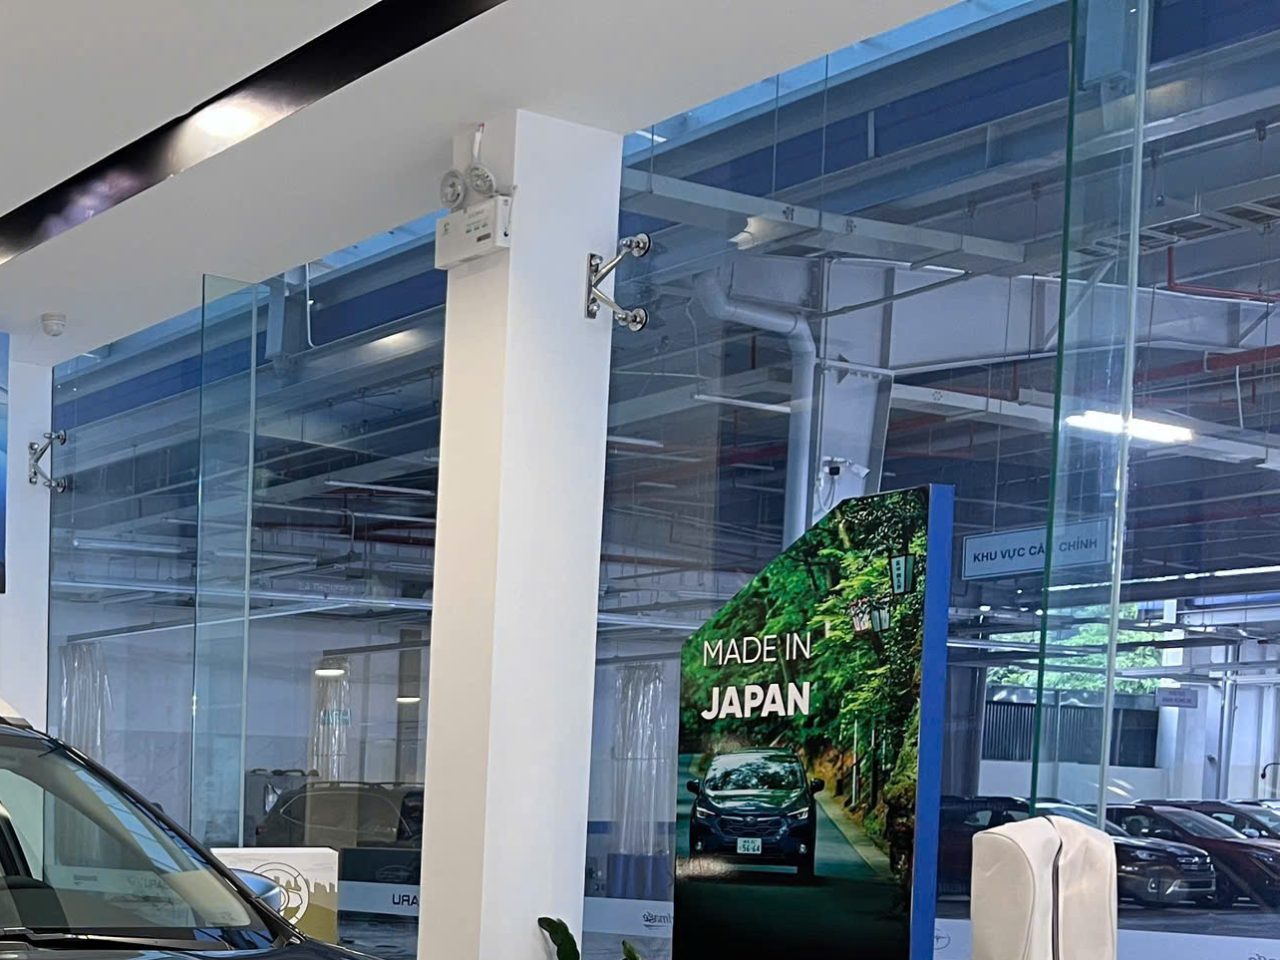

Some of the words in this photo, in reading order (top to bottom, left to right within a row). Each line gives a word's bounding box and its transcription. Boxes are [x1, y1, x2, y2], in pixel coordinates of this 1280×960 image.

[973, 550, 997, 562] KHU
[1000, 547, 1026, 560] VỰC
[1029, 542, 1046, 555] CÂ
[704, 634, 777, 667] MADE
[786, 631, 811, 661] IN
[701, 681, 810, 720] JAPAN
